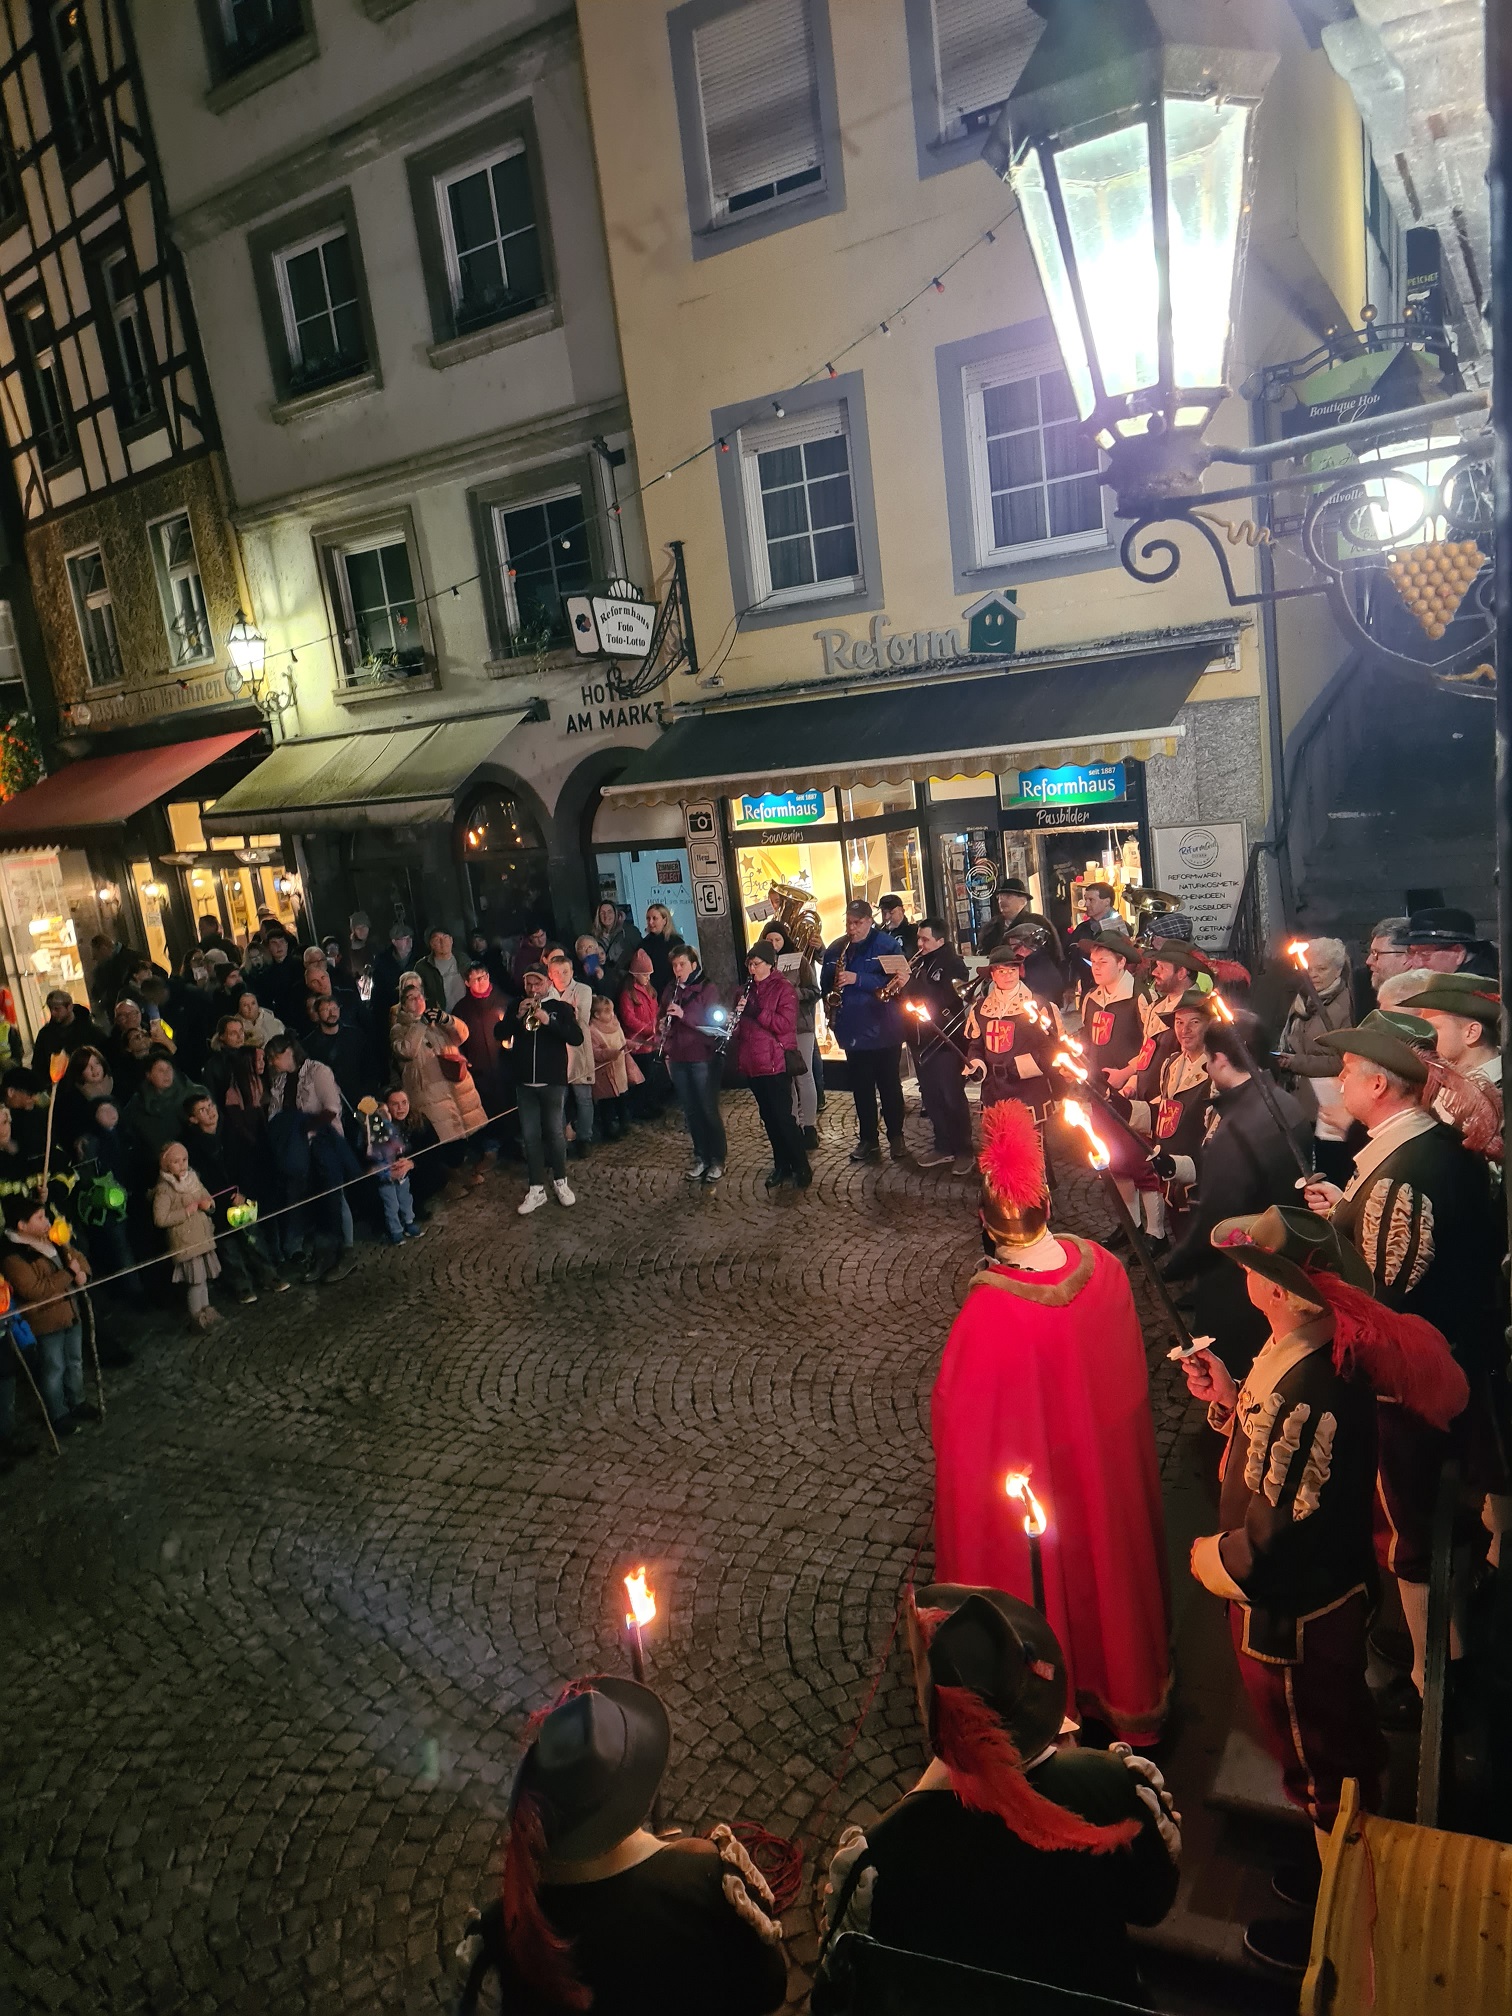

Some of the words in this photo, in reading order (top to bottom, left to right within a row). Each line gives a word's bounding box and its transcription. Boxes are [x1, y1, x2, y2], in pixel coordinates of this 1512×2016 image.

[1309, 399, 1356, 417] Boutique
[1358, 394, 1380, 407] Hot
[600, 606, 650, 630] Reformhaus
[617, 621, 634, 633] Foto
[812, 614, 971, 675] Reform
[566, 711, 593, 735] AM
[599, 701, 664, 730] MARKT
[1088, 768, 1100, 776] seit
[1101, 766, 1116, 775] 1887
[1022, 775, 1116, 803] Reformhaus
[744, 800, 818, 822] Reformhaus
[1036, 807, 1090, 825] Passbilder
[761, 829, 804, 845] Souvenirs
[659, 872, 680, 882] BELEGT
[1168, 871, 1222, 881] REFORMWAREN
[1179, 880, 1240, 890] NATURKOSMETIK
[1189, 903, 1232, 911] PASSBILDER
